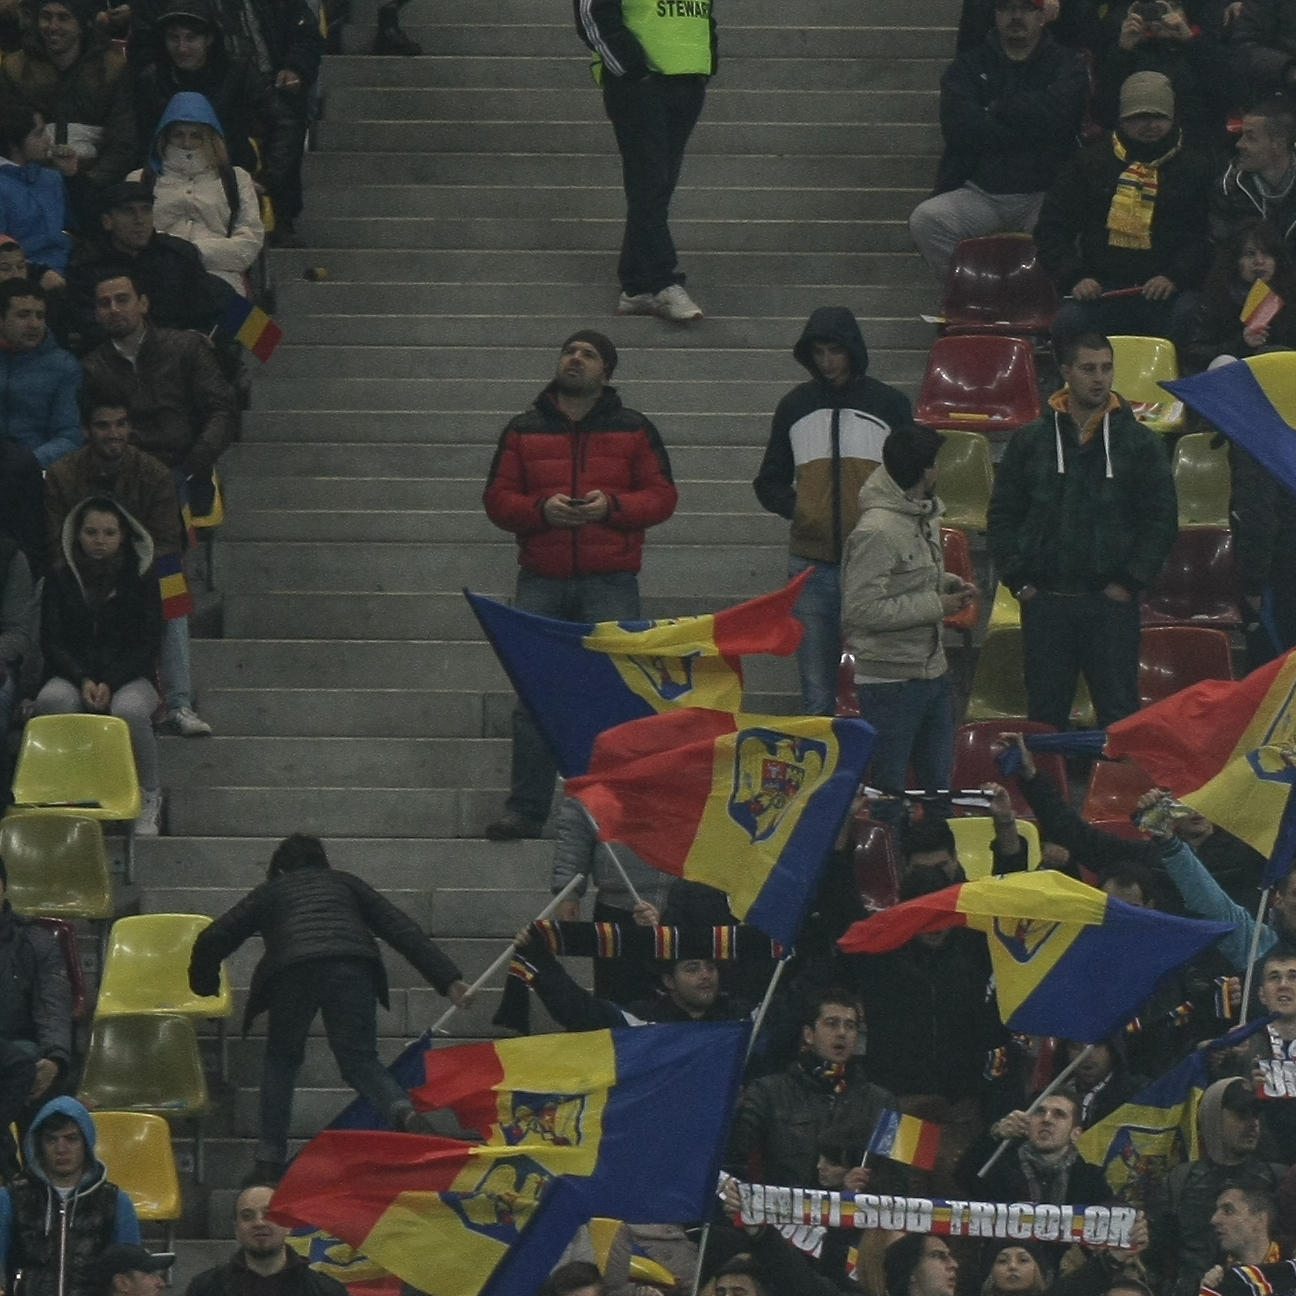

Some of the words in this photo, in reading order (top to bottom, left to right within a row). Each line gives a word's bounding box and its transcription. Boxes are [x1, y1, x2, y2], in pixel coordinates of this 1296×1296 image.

[740, 1183, 841, 1226] UNITI
[854, 1193, 934, 1232] SUB
[945, 1199, 1138, 1250] TRICOLOR
